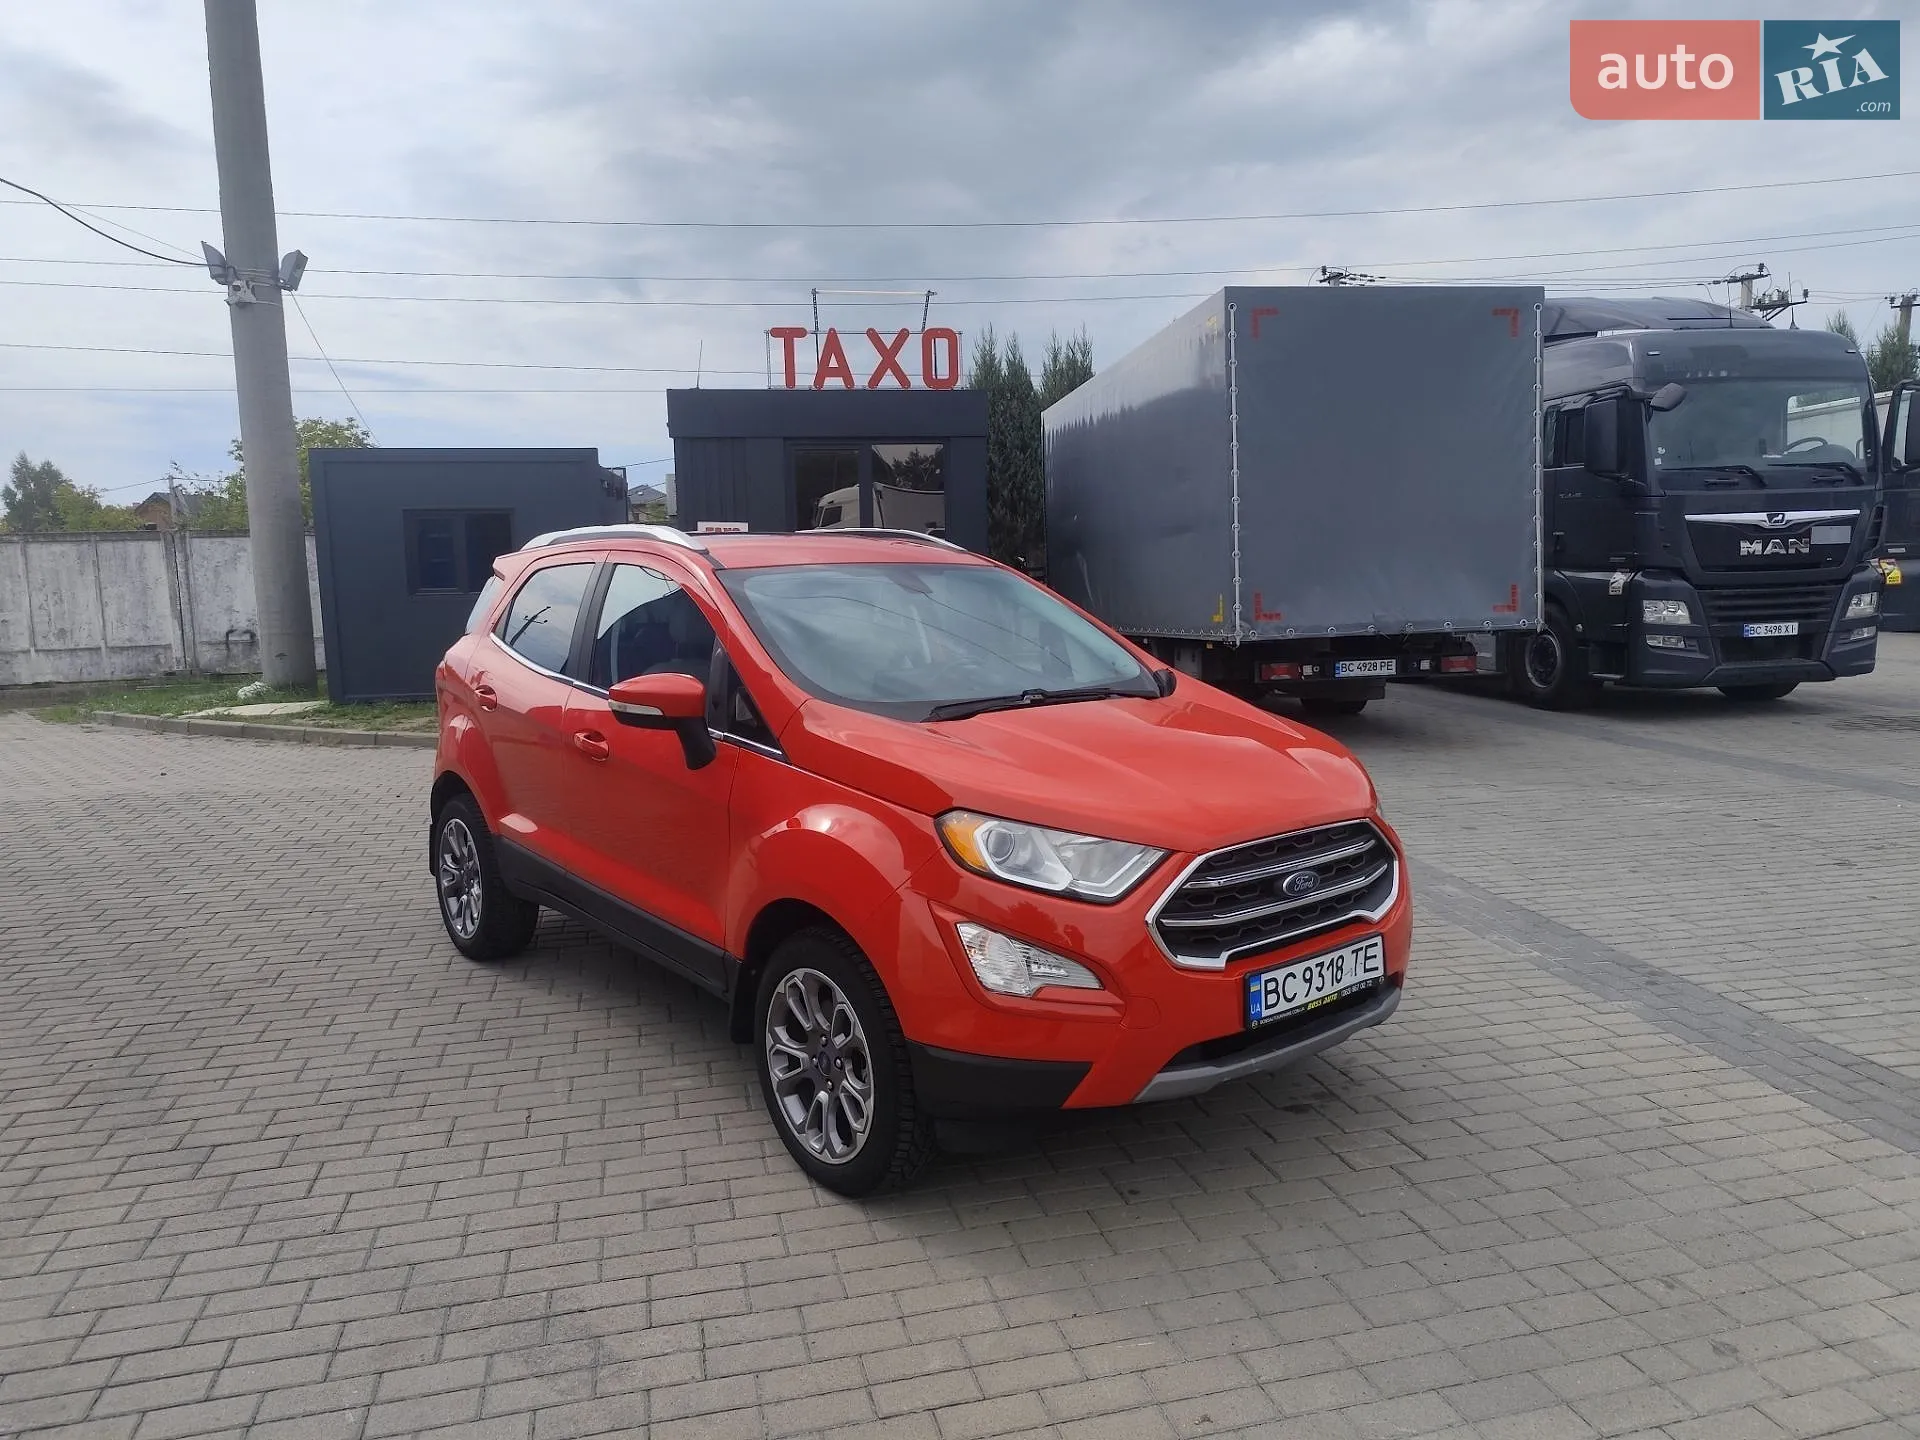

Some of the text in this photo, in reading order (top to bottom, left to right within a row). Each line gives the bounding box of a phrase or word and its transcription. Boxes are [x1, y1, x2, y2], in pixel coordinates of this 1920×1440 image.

[1740, 538, 1810, 556] MAN
[1750, 625, 1762, 636] BC
[1764, 625, 1783, 635] 3498
[1341, 662, 1355, 673] BC
[1357, 661, 1378, 672] 4928
[1380, 661, 1393, 671] PE
[1294, 875, 1314, 891] Ford
[1264, 972, 1298, 1010] BC
[1302, 954, 1345, 998] 9318
[1352, 942, 1379, 977] TE
[1250, 1003, 1260, 1014] UA
